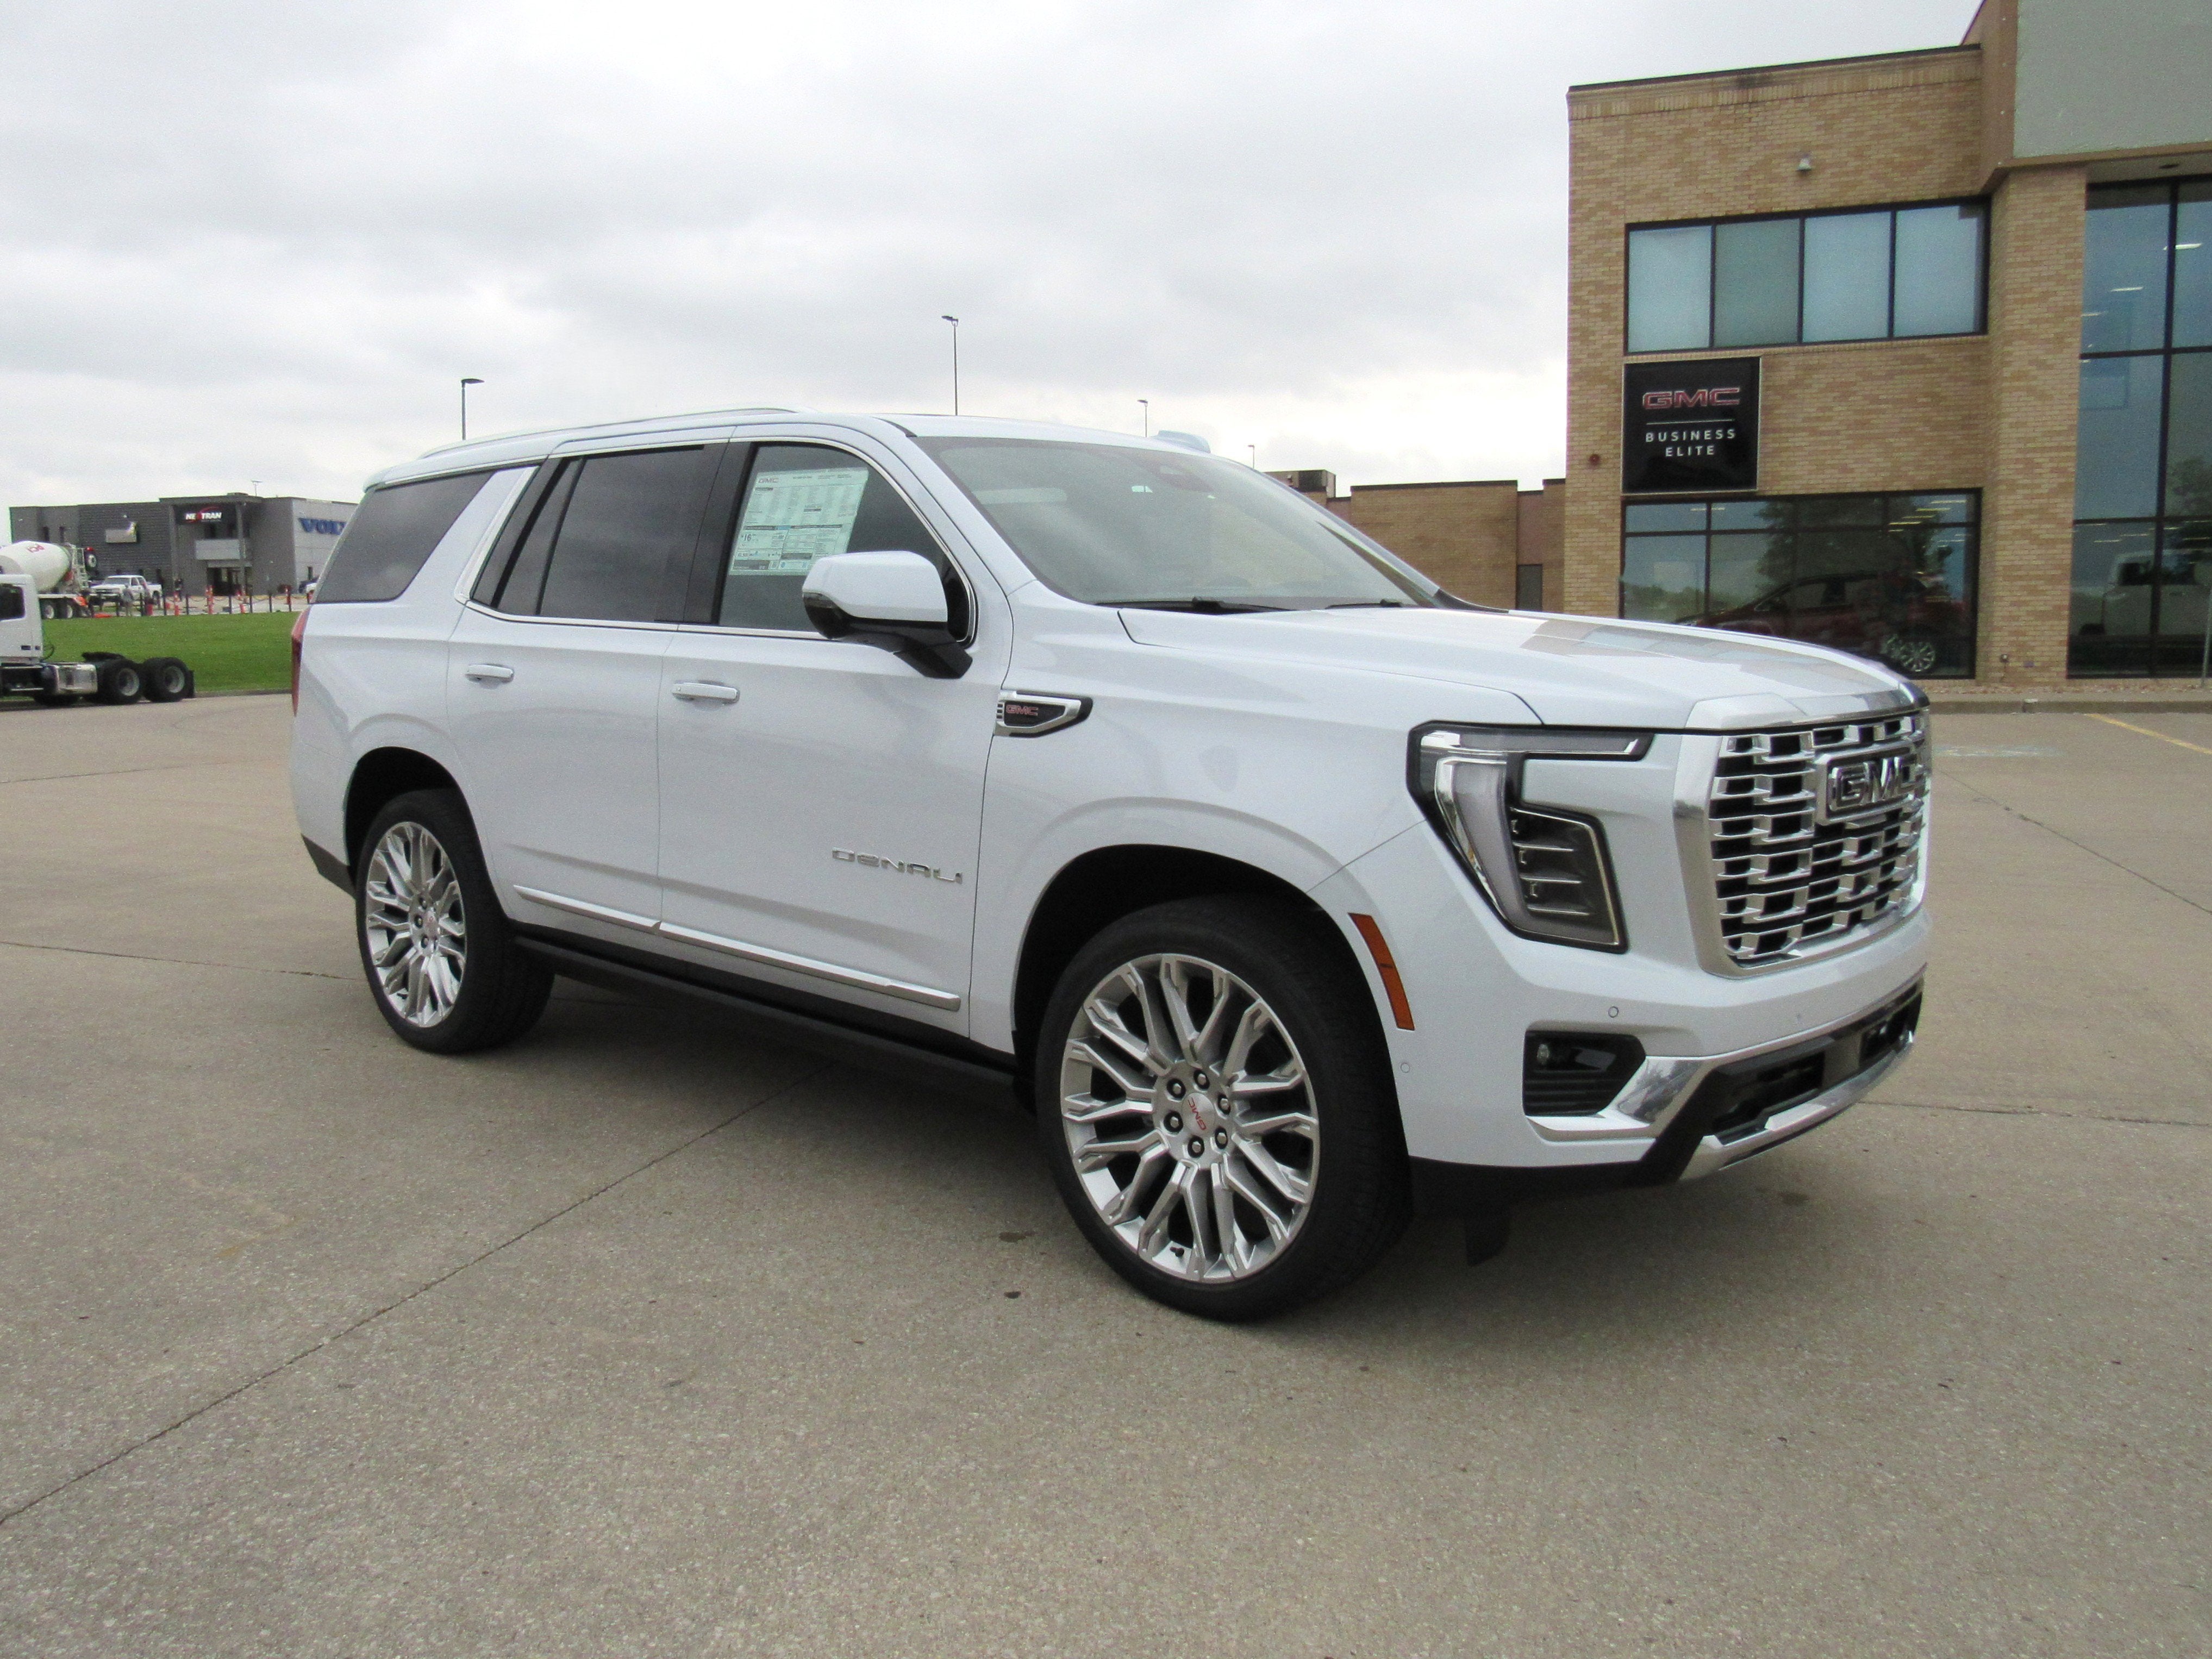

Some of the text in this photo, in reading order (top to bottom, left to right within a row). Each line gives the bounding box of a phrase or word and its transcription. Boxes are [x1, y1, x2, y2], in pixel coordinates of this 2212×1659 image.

[1642, 387, 1740, 410] GMC
[1646, 429, 1736, 442] BUSINESS
[1665, 445, 1714, 456] ELITE
[1006, 705, 1039, 716] GMC
[1827, 756, 1925, 811] GMC
[832, 847, 963, 884] DENALI
[1188, 1097, 1207, 1130] GMC
